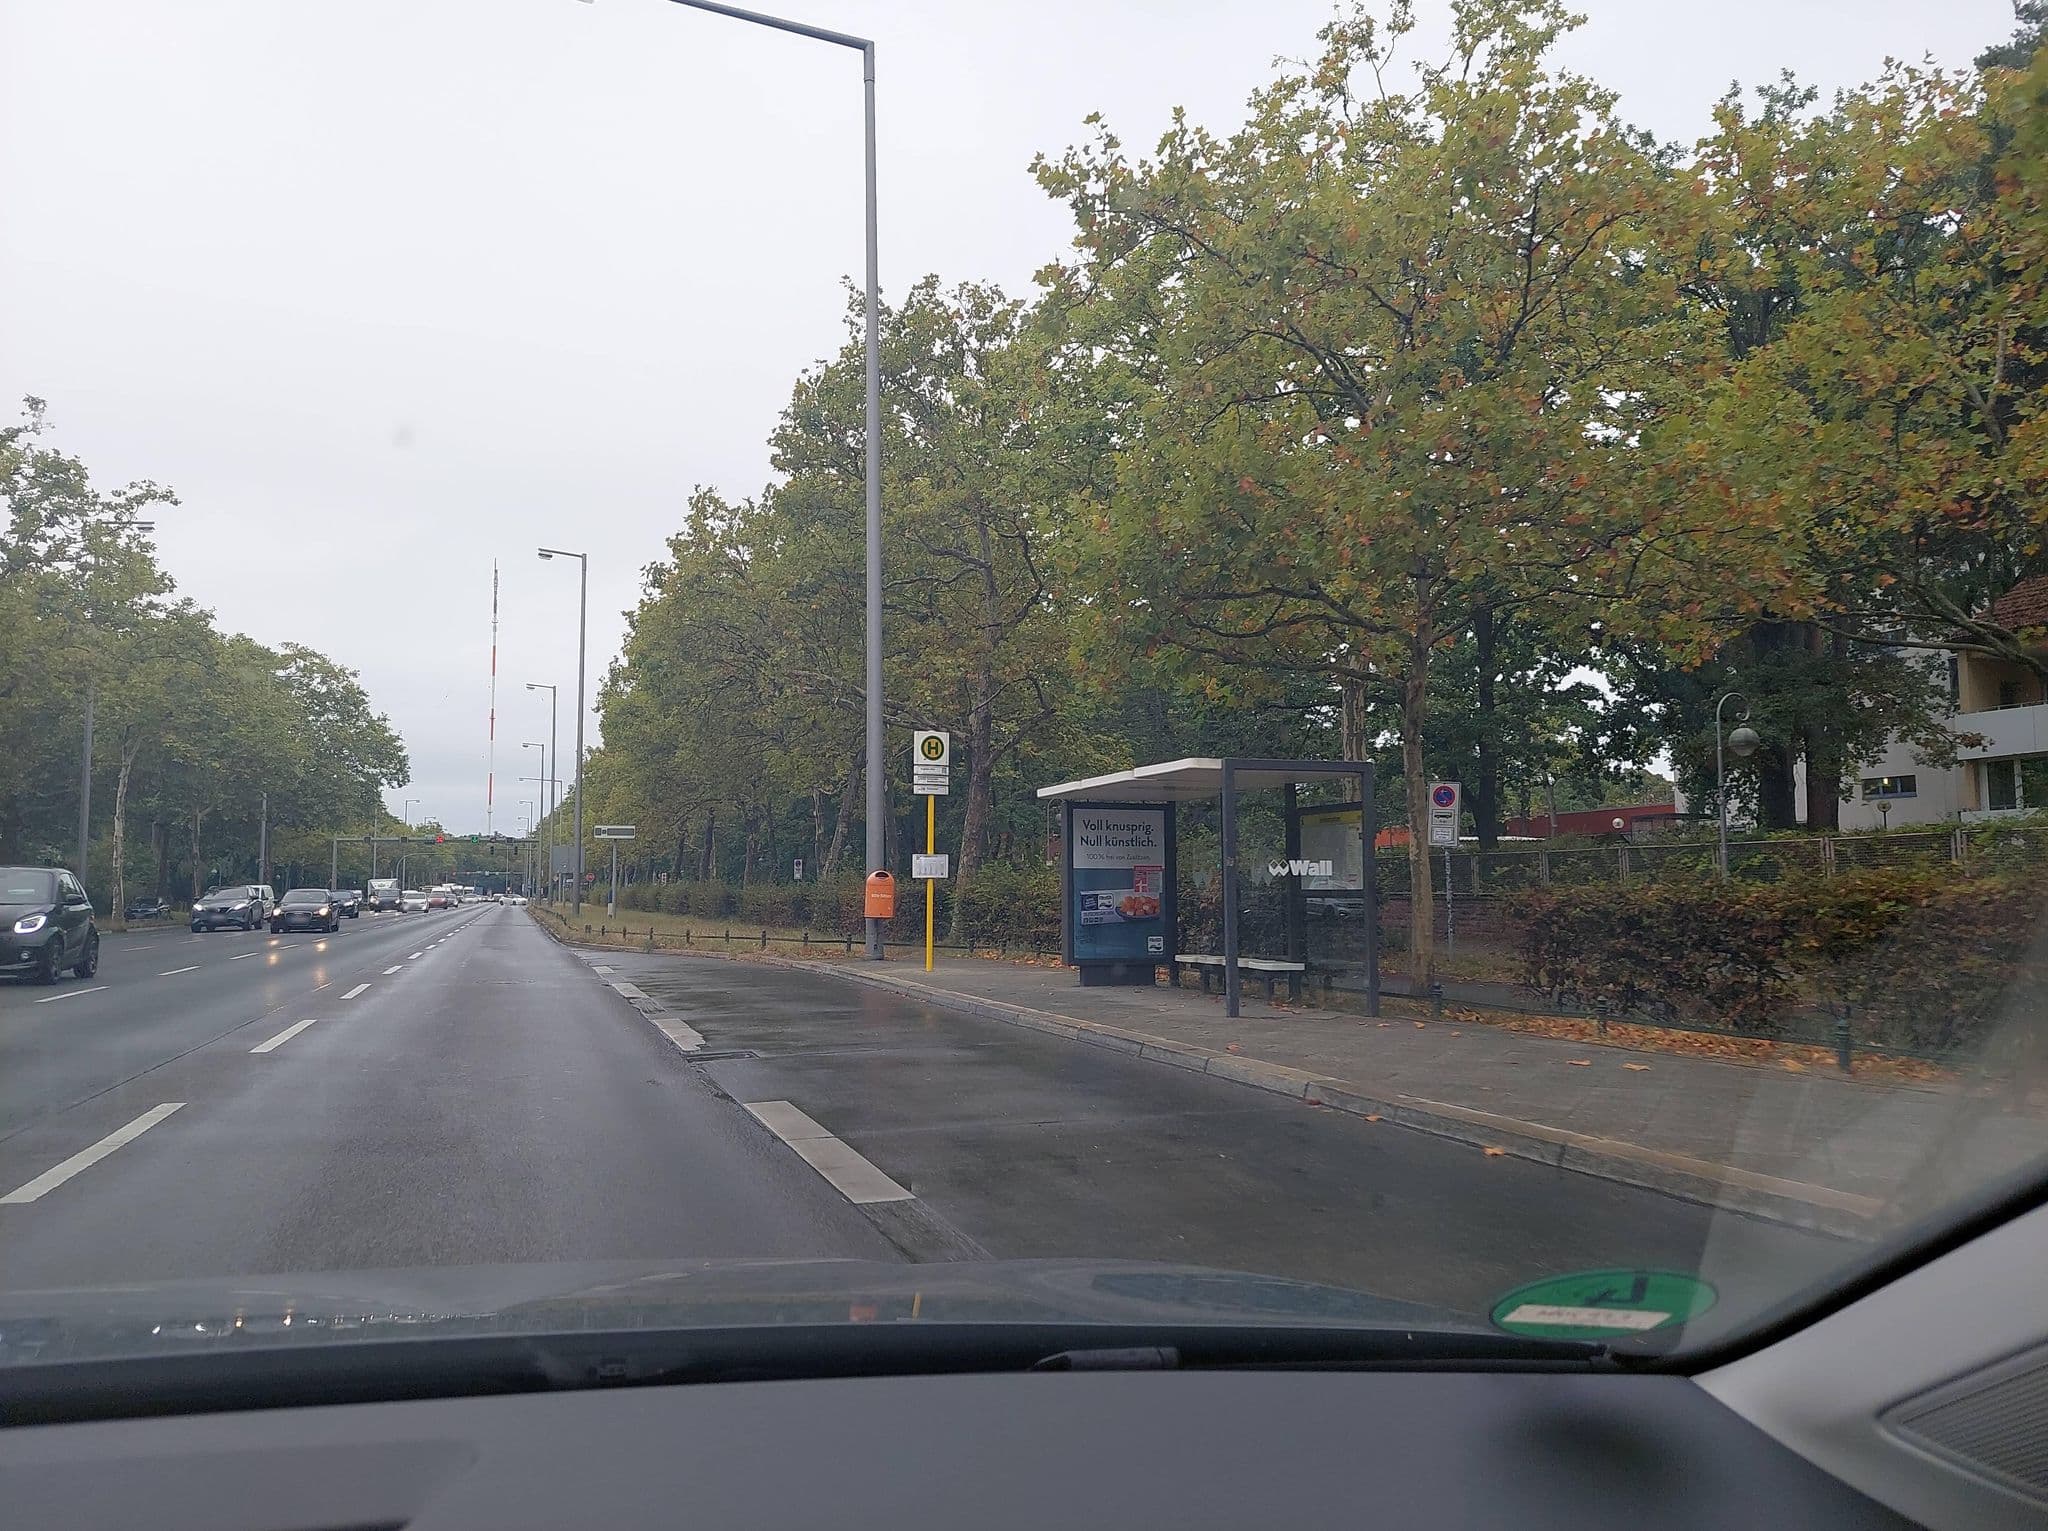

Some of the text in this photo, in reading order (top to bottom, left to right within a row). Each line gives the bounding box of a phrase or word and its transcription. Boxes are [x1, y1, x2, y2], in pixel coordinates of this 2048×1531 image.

[928, 741, 938, 755] H
[1082, 819, 1154, 836] Voll knusprig.
[1080, 834, 1157, 848] Null künstlich.
[1289, 860, 1333, 877] Wall
